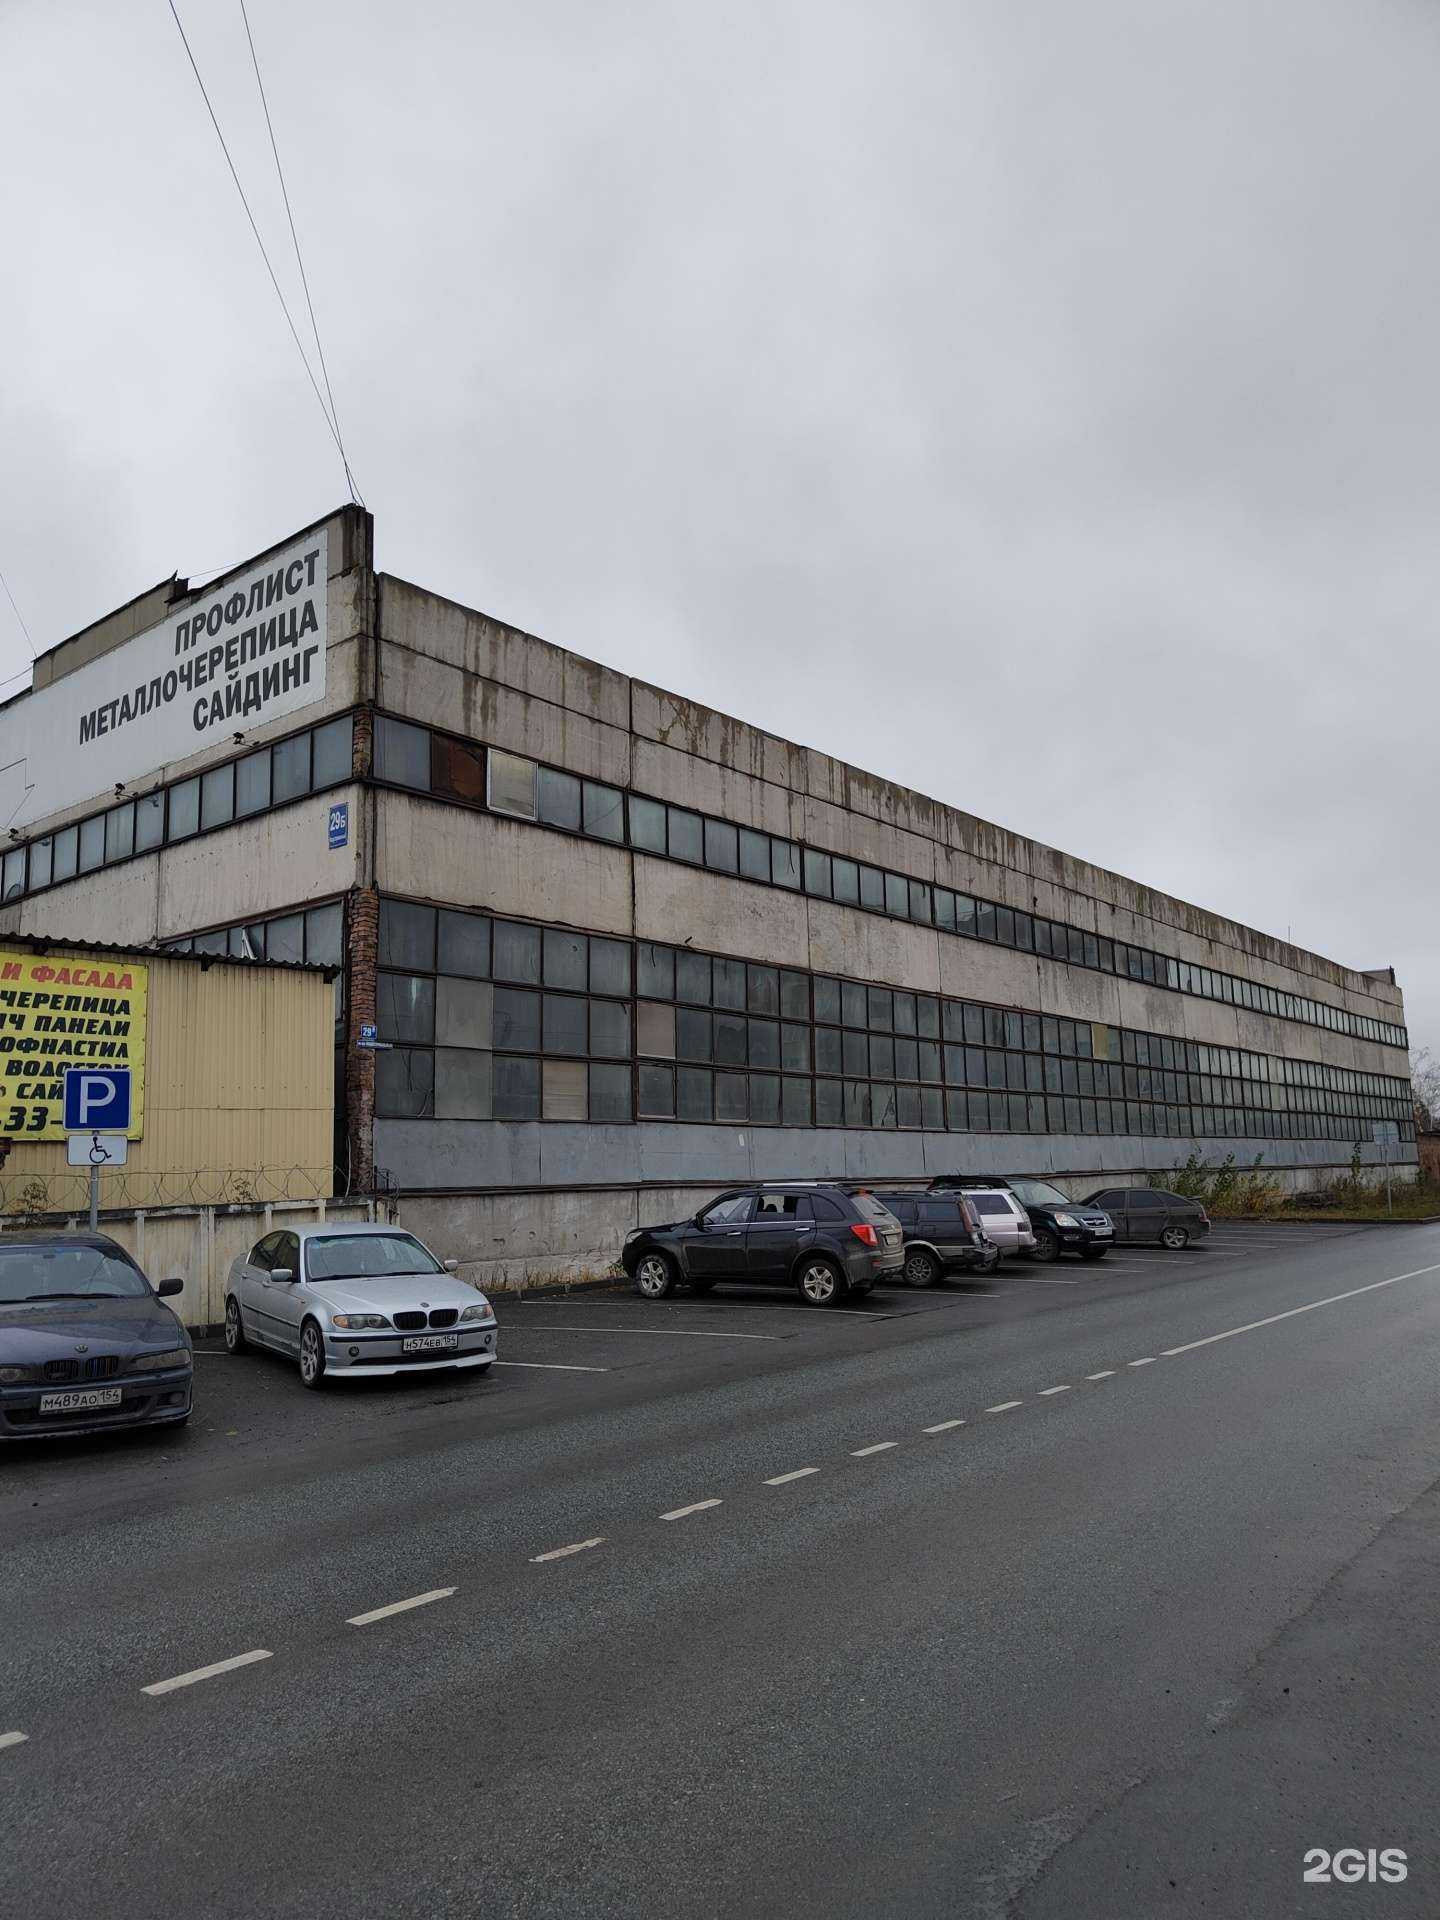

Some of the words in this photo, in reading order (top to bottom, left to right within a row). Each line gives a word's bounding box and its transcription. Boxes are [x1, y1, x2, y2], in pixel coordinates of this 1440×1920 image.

[175, 550, 319, 656] ПРОФЛИСТ
[79, 600, 319, 745] МЕТАЛЛОЧЕРЕПИЦА
[192, 646, 319, 732] САЙДИНГ
[1, 962, 22, 980] И
[31, 966, 133, 989] ФАСАДА
[34, 1015, 131, 1036] ПАНЕЛИ
